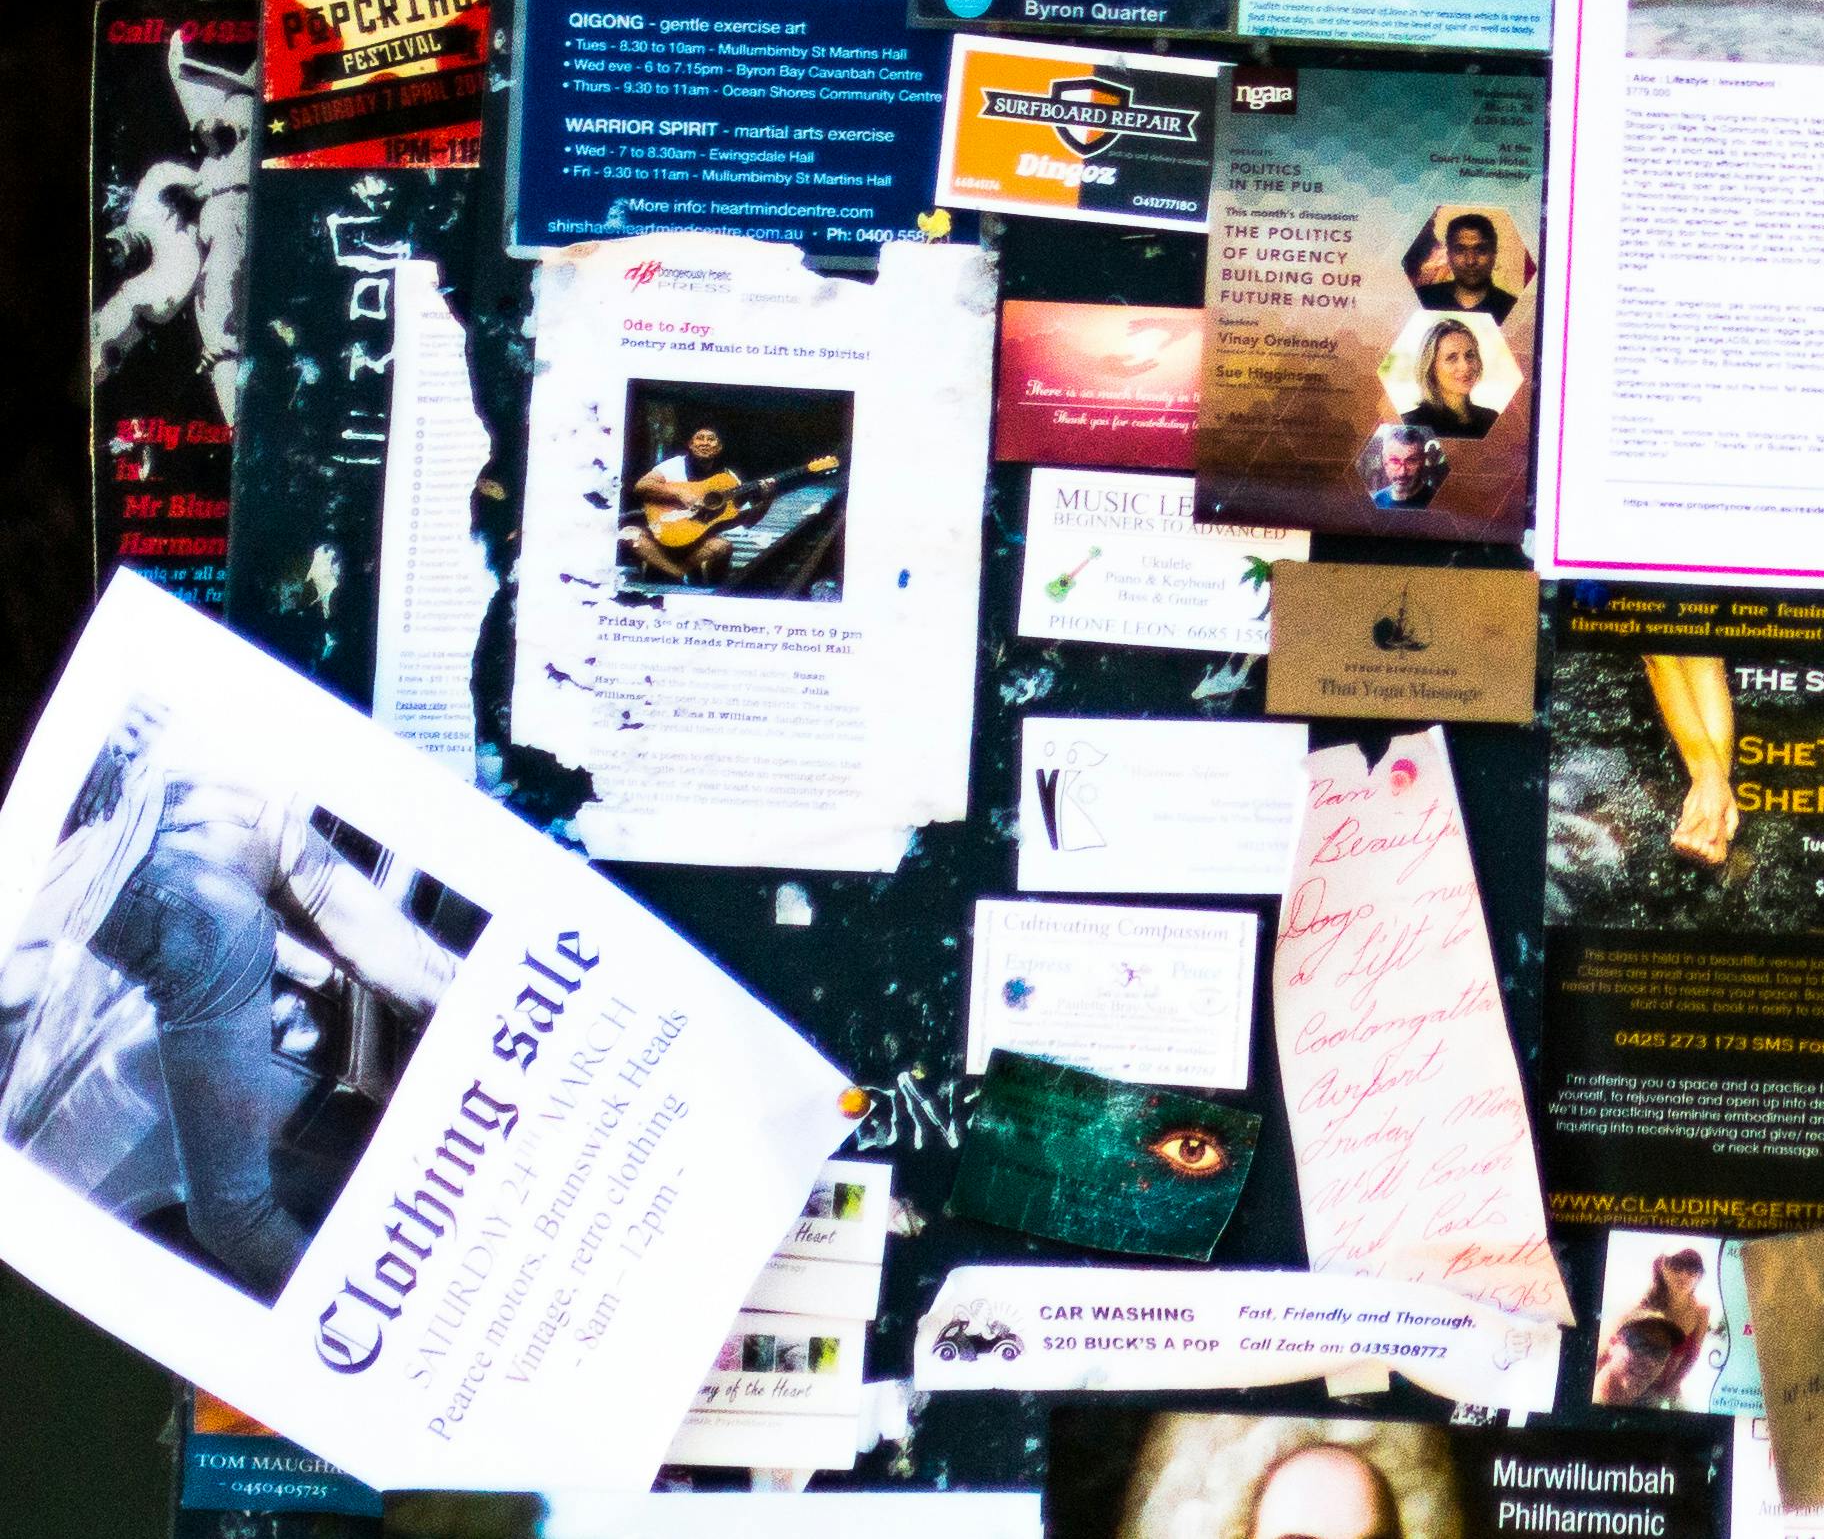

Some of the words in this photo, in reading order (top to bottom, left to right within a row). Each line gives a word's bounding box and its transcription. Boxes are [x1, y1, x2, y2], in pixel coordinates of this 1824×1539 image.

[343, 33, 442, 74] FESTIVAL
[1235, 84, 1292, 109] ngara
[565, 118, 654, 137] WARRIOR
[658, 120, 718, 137] SPIRIT
[994, 96, 1107, 128] SURFBOARD
[1111, 110, 1183, 133] REPAIR
[1016, 152, 1117, 188] Dingoz
[1224, 225, 1261, 239] THE
[1268, 226, 1353, 244] POLITICS
[1223, 246, 1248, 261] OF
[1257, 248, 1348, 265] URGENCY
[534, 1090, 629, 1243] Brunswick
[618, 1007, 690, 1096] Heads
[314, 1078, 519, 1374] Clothing
[492, 930, 600, 1077] sale
[1039, 1304, 1082, 1324] CAR
[1087, 1306, 1196, 1325] WASHING
[1493, 1459, 1674, 1496] Murwillumbah
[1498, 1502, 1665, 1537] Philharmonic
